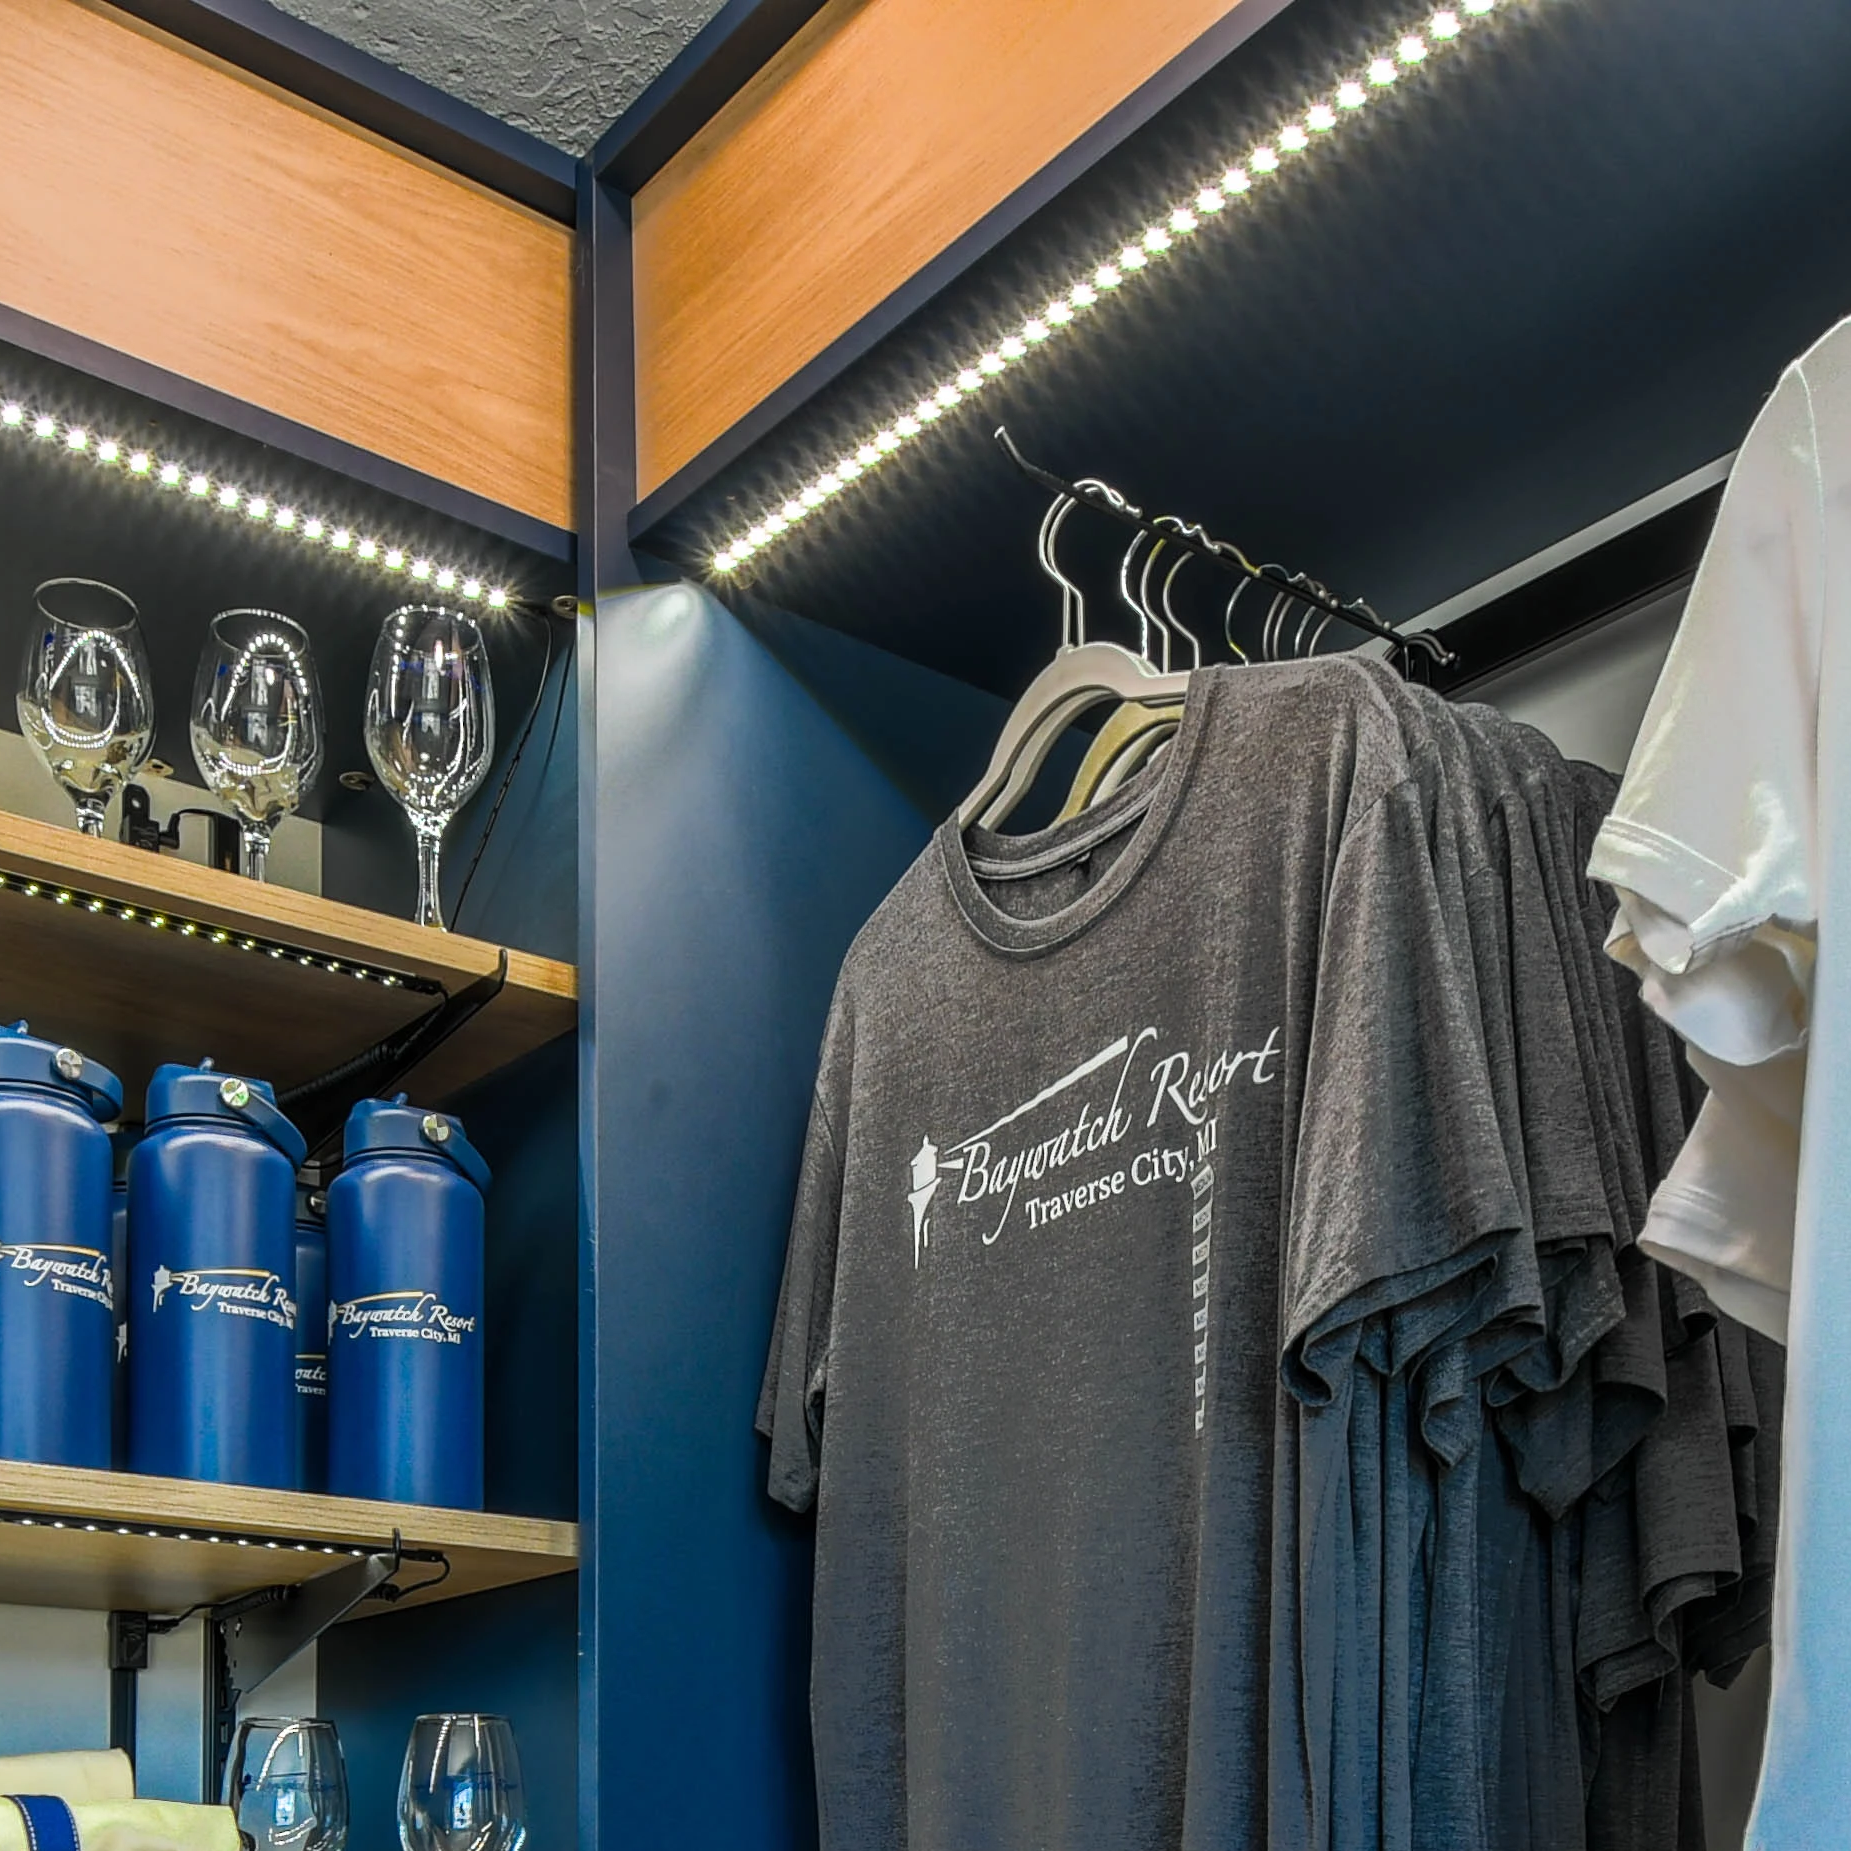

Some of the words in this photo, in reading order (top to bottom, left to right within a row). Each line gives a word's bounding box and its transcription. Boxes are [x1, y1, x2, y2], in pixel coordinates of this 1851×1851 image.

[957, 1027, 1158, 1246] Baywatch
[1025, 1167, 1126, 1230] Traverse
[1130, 1144, 1195, 1187] City,
[1195, 1118, 1219, 1163] MI
[11, 1246, 107, 1287] Baywatch
[179, 1274, 281, 1311] Baywatch
[340, 1293, 436, 1339] Baywatch
[428, 1305, 476, 1333] Resort
[369, 1325, 420, 1340] Traverse
